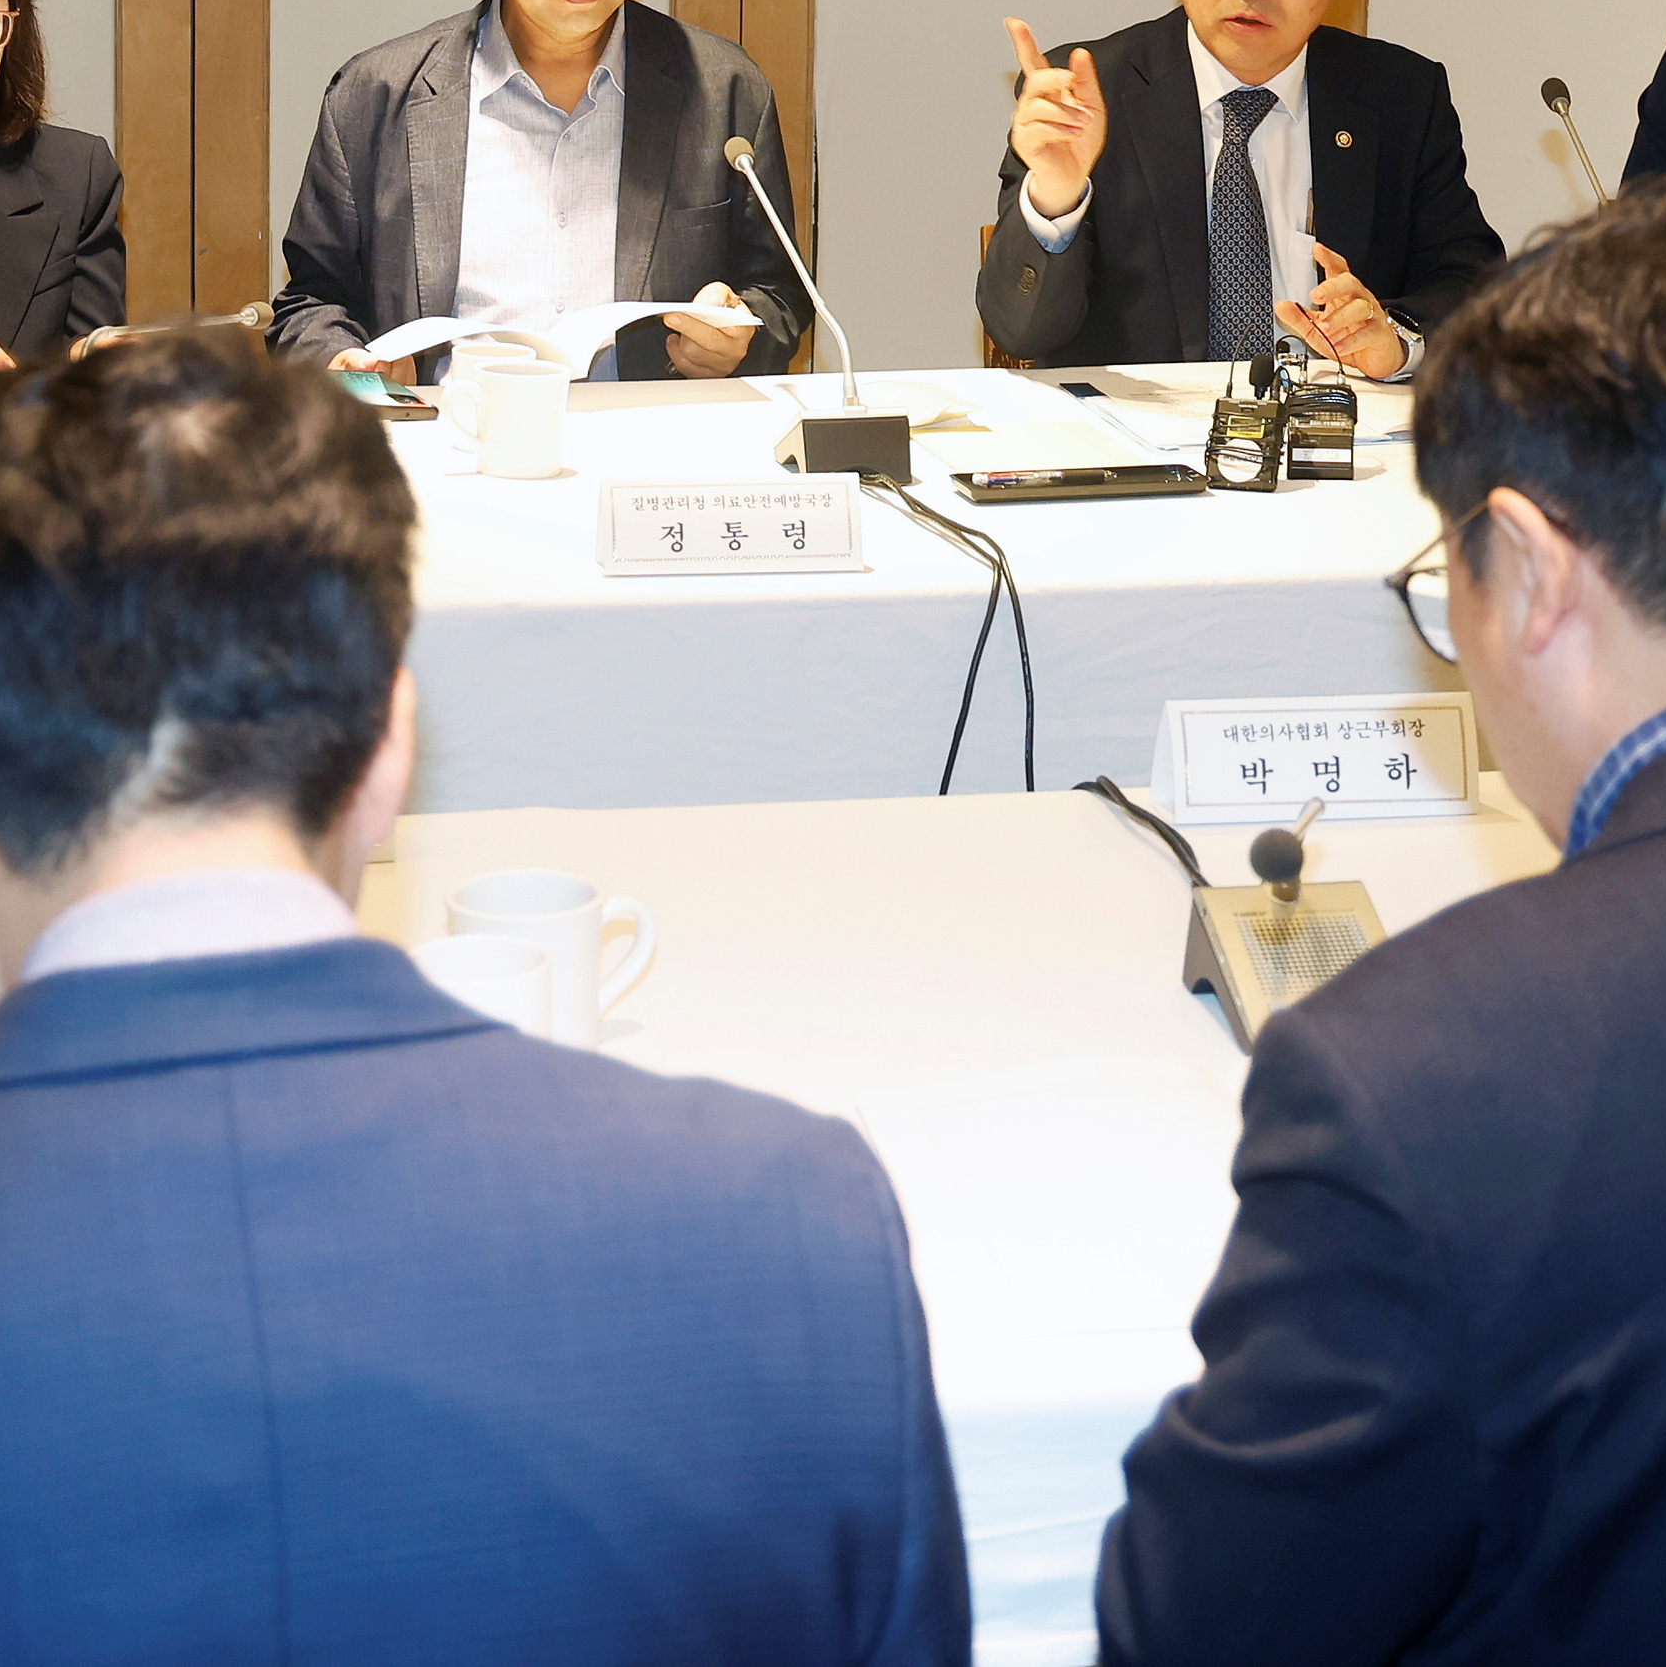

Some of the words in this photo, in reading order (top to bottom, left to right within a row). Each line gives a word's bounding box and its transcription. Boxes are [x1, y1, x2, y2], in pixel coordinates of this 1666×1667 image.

[631, 494, 706, 512] 질병관리청
[712, 492, 834, 510] 의료안전예방국장
[1222, 720, 1329, 744] 대한의사협회
[1337, 717, 1426, 740] 상근부회장
